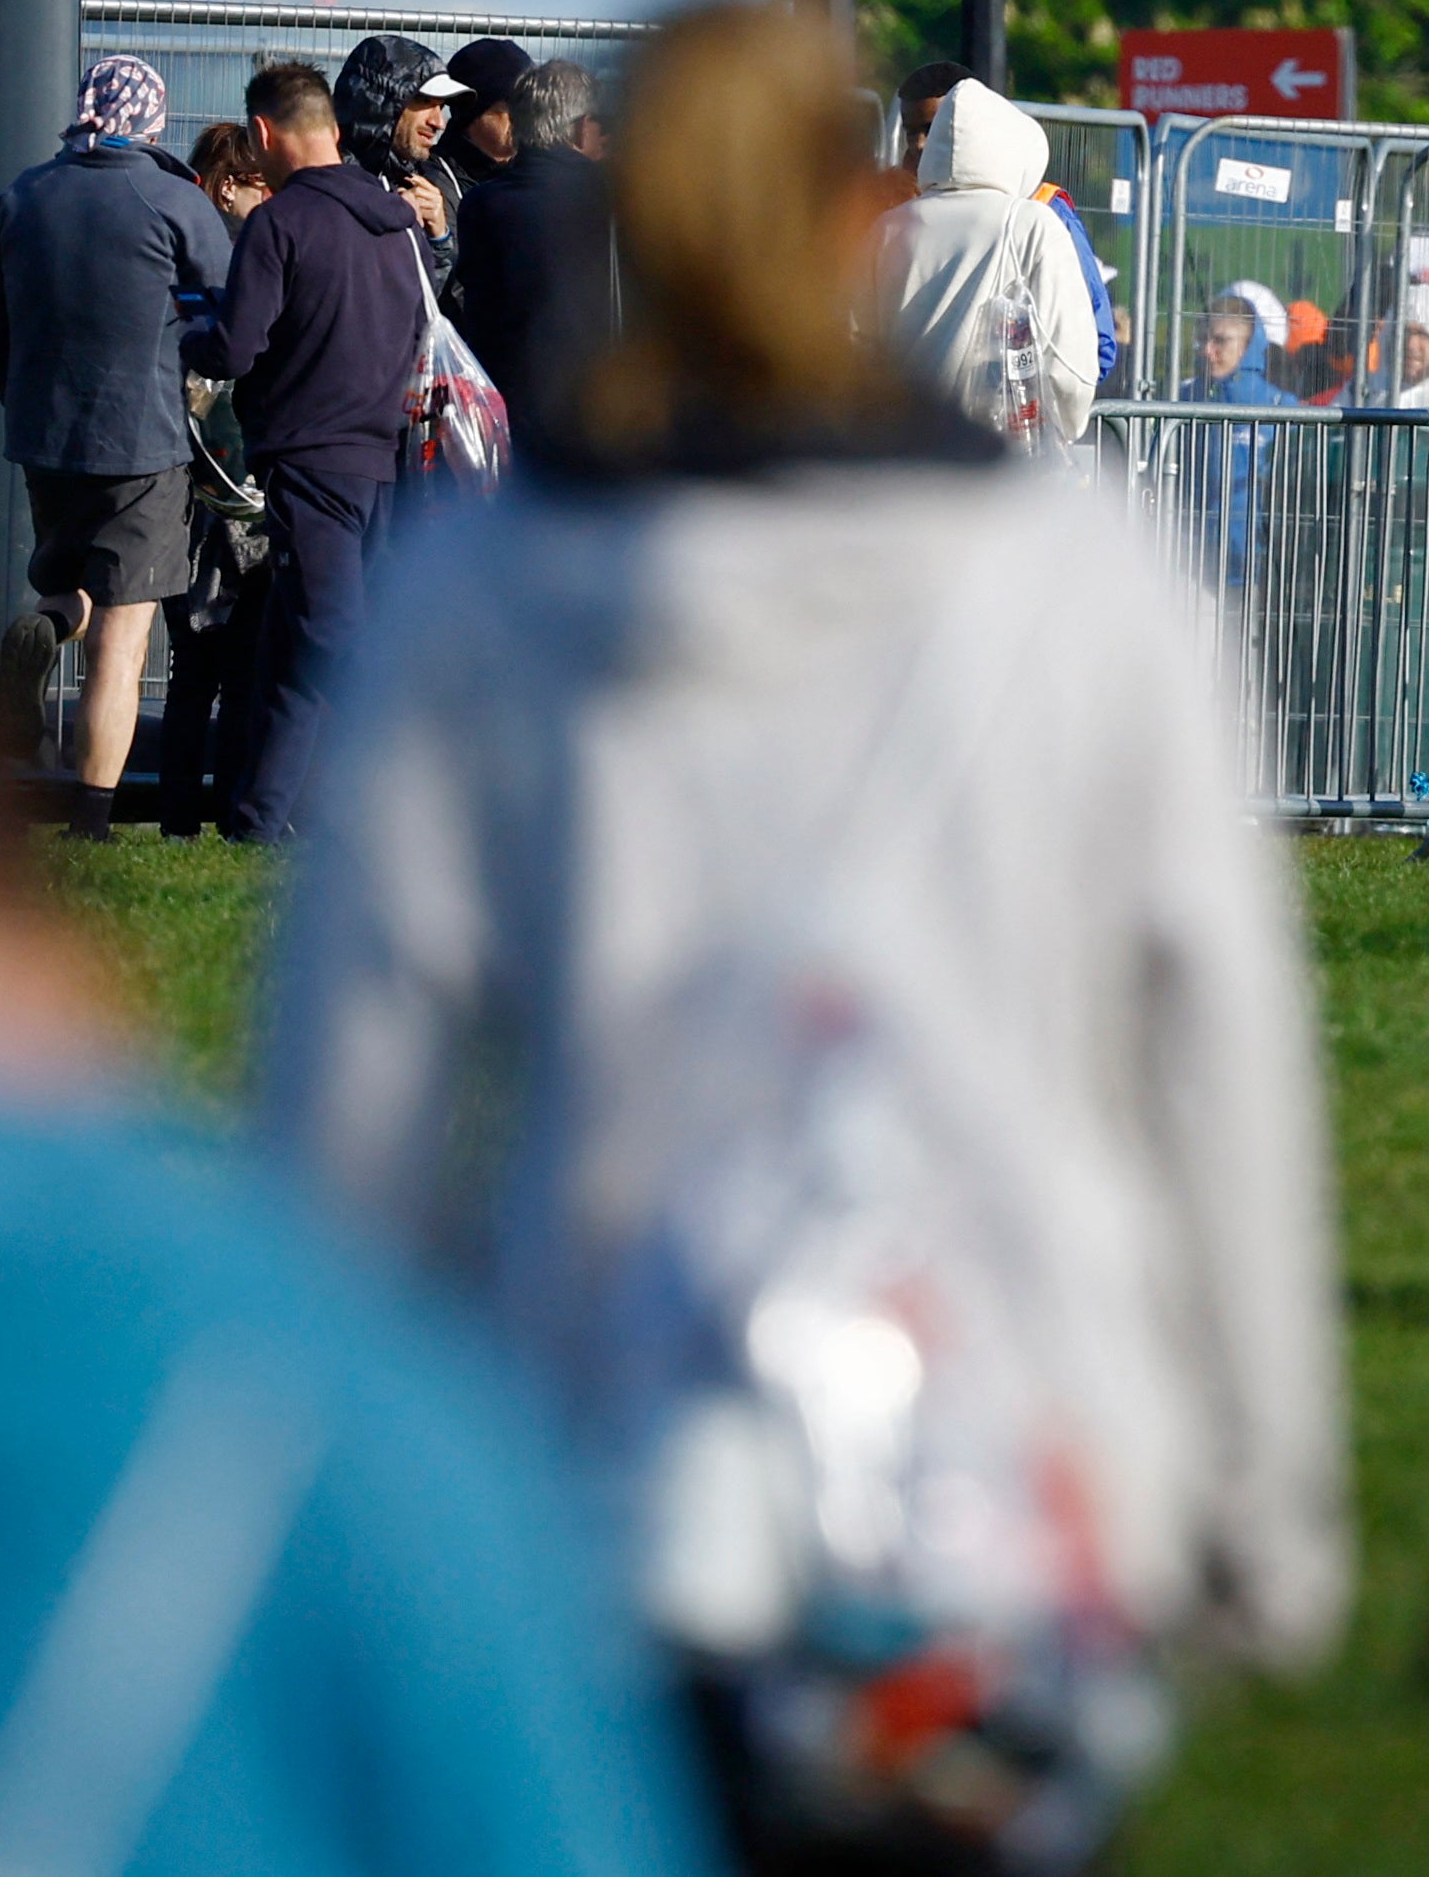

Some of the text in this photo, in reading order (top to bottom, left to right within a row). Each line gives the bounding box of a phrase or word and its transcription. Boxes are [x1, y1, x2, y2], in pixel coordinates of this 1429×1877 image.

[1132, 57, 1181, 82] RED
[1132, 84, 1249, 110] RUNNERS
[1223, 177, 1277, 199] arena
